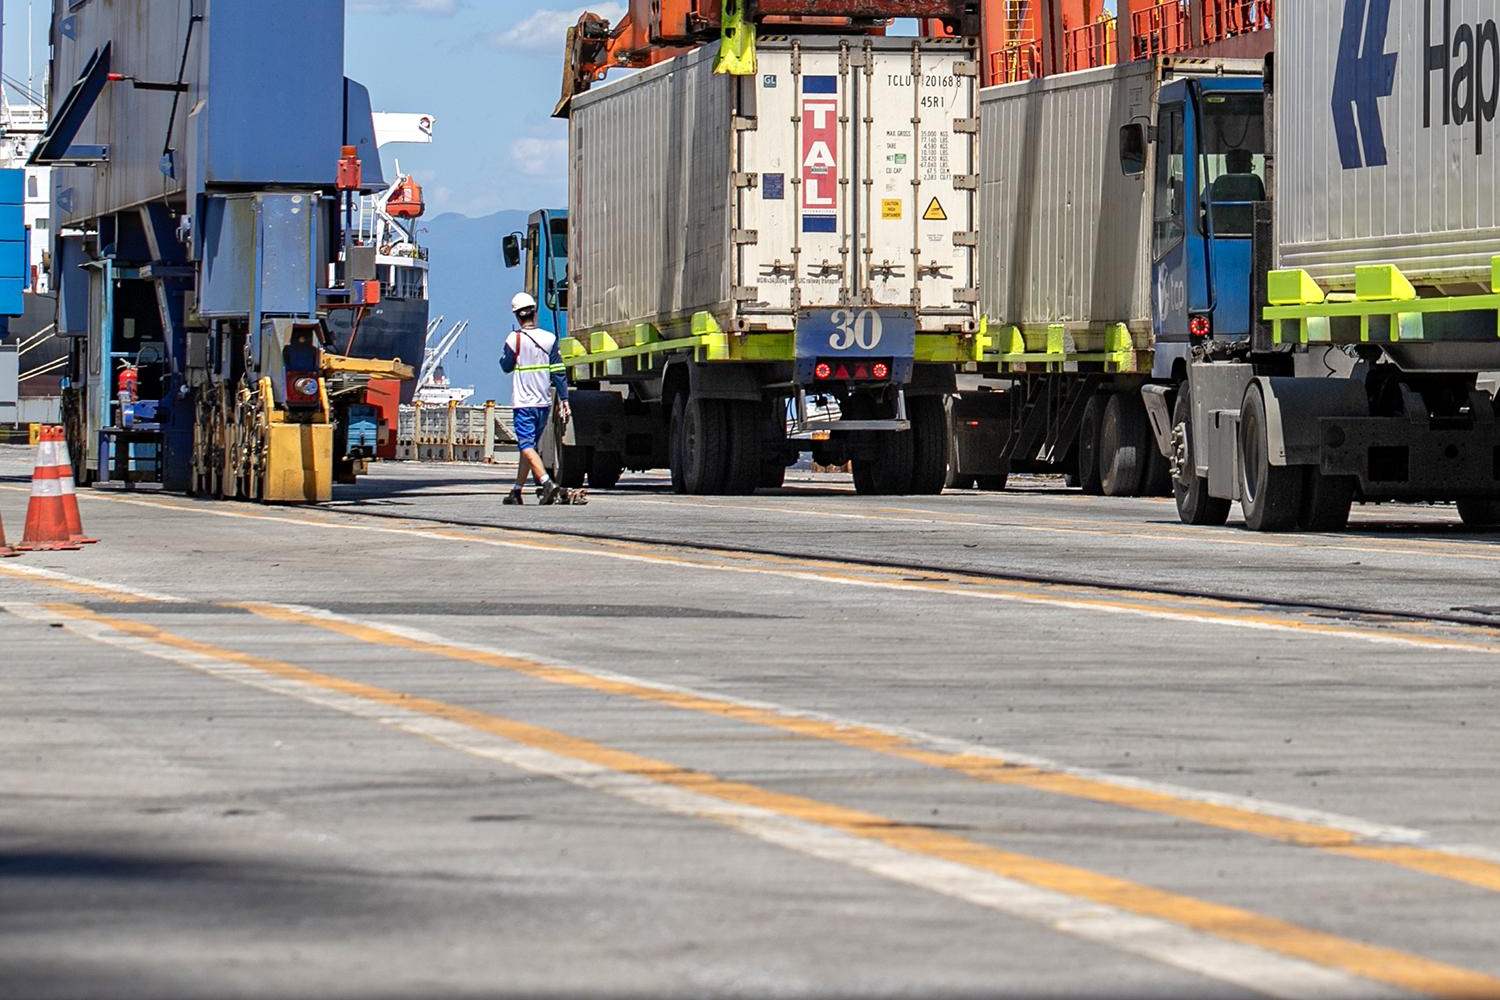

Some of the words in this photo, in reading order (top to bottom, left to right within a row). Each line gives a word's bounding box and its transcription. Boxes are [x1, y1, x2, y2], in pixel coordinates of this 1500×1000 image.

[764, 76, 776, 84] GL
[888, 75, 911, 86] TCLU
[921, 96, 944, 108] 45R1
[803, 103, 836, 204] TAL
[1170, 274, 1184, 316] tcp
[829, 309, 883, 350] 30
